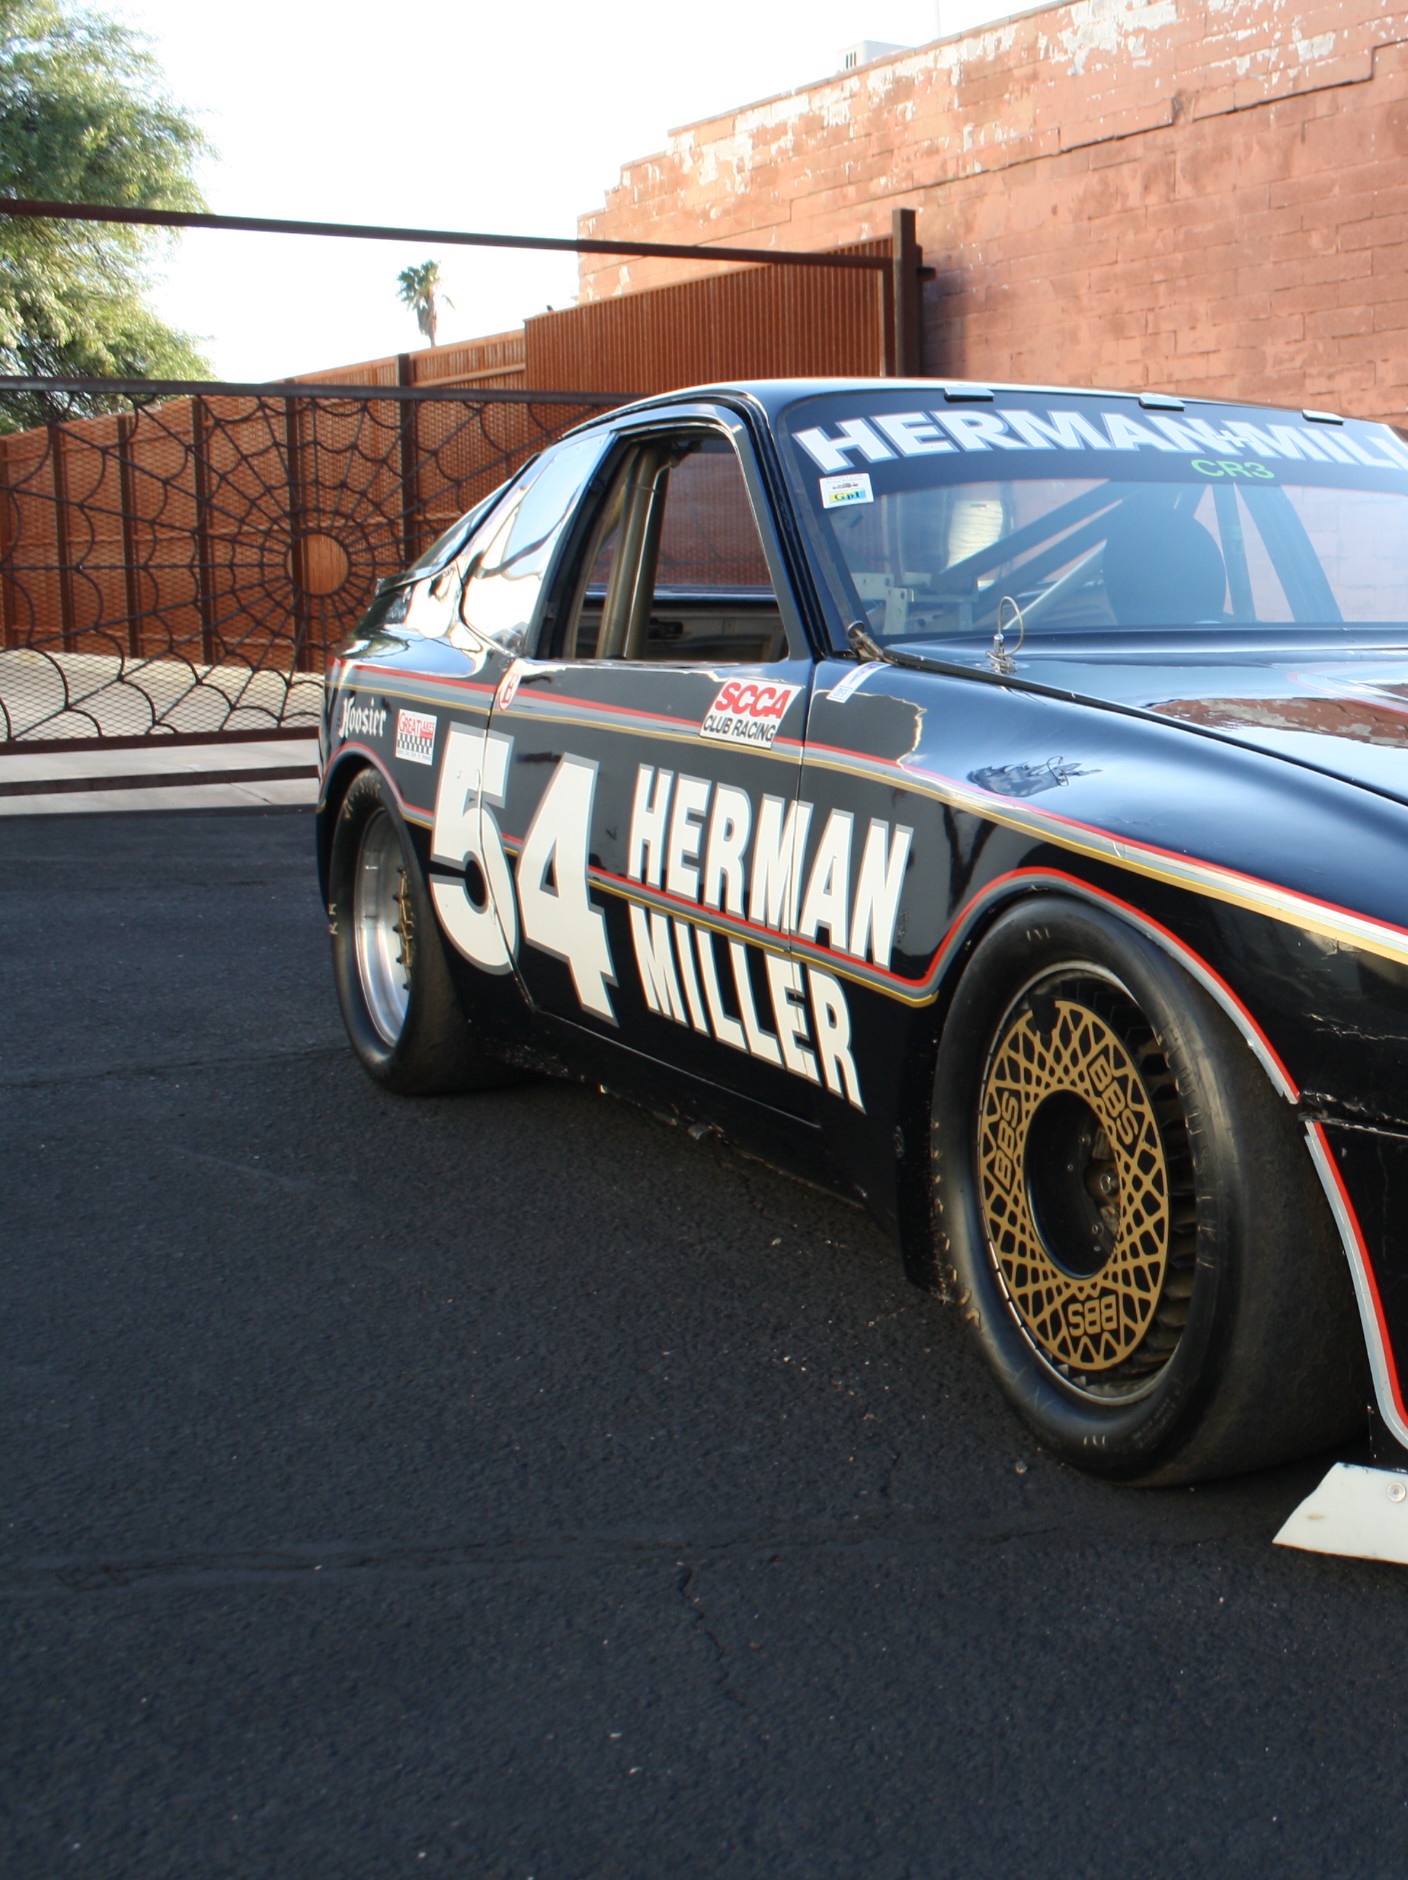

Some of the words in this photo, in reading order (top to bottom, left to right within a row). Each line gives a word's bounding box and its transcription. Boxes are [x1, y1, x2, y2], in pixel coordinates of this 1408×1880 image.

[1191, 459, 1275, 479] CR3
[338, 696, 387, 739] Hoosier
[703, 714, 733, 735] CLUB
[732, 719, 776, 742] RACING
[714, 681, 792, 719] SCCA
[430, 721, 619, 1027] 54
[627, 763, 913, 971] HERMAN
[627, 899, 867, 1115] MILLER
[1088, 1054, 1139, 1145] BBS
[994, 1090, 1019, 1191] BBS
[1066, 1293, 1118, 1338] BBS
